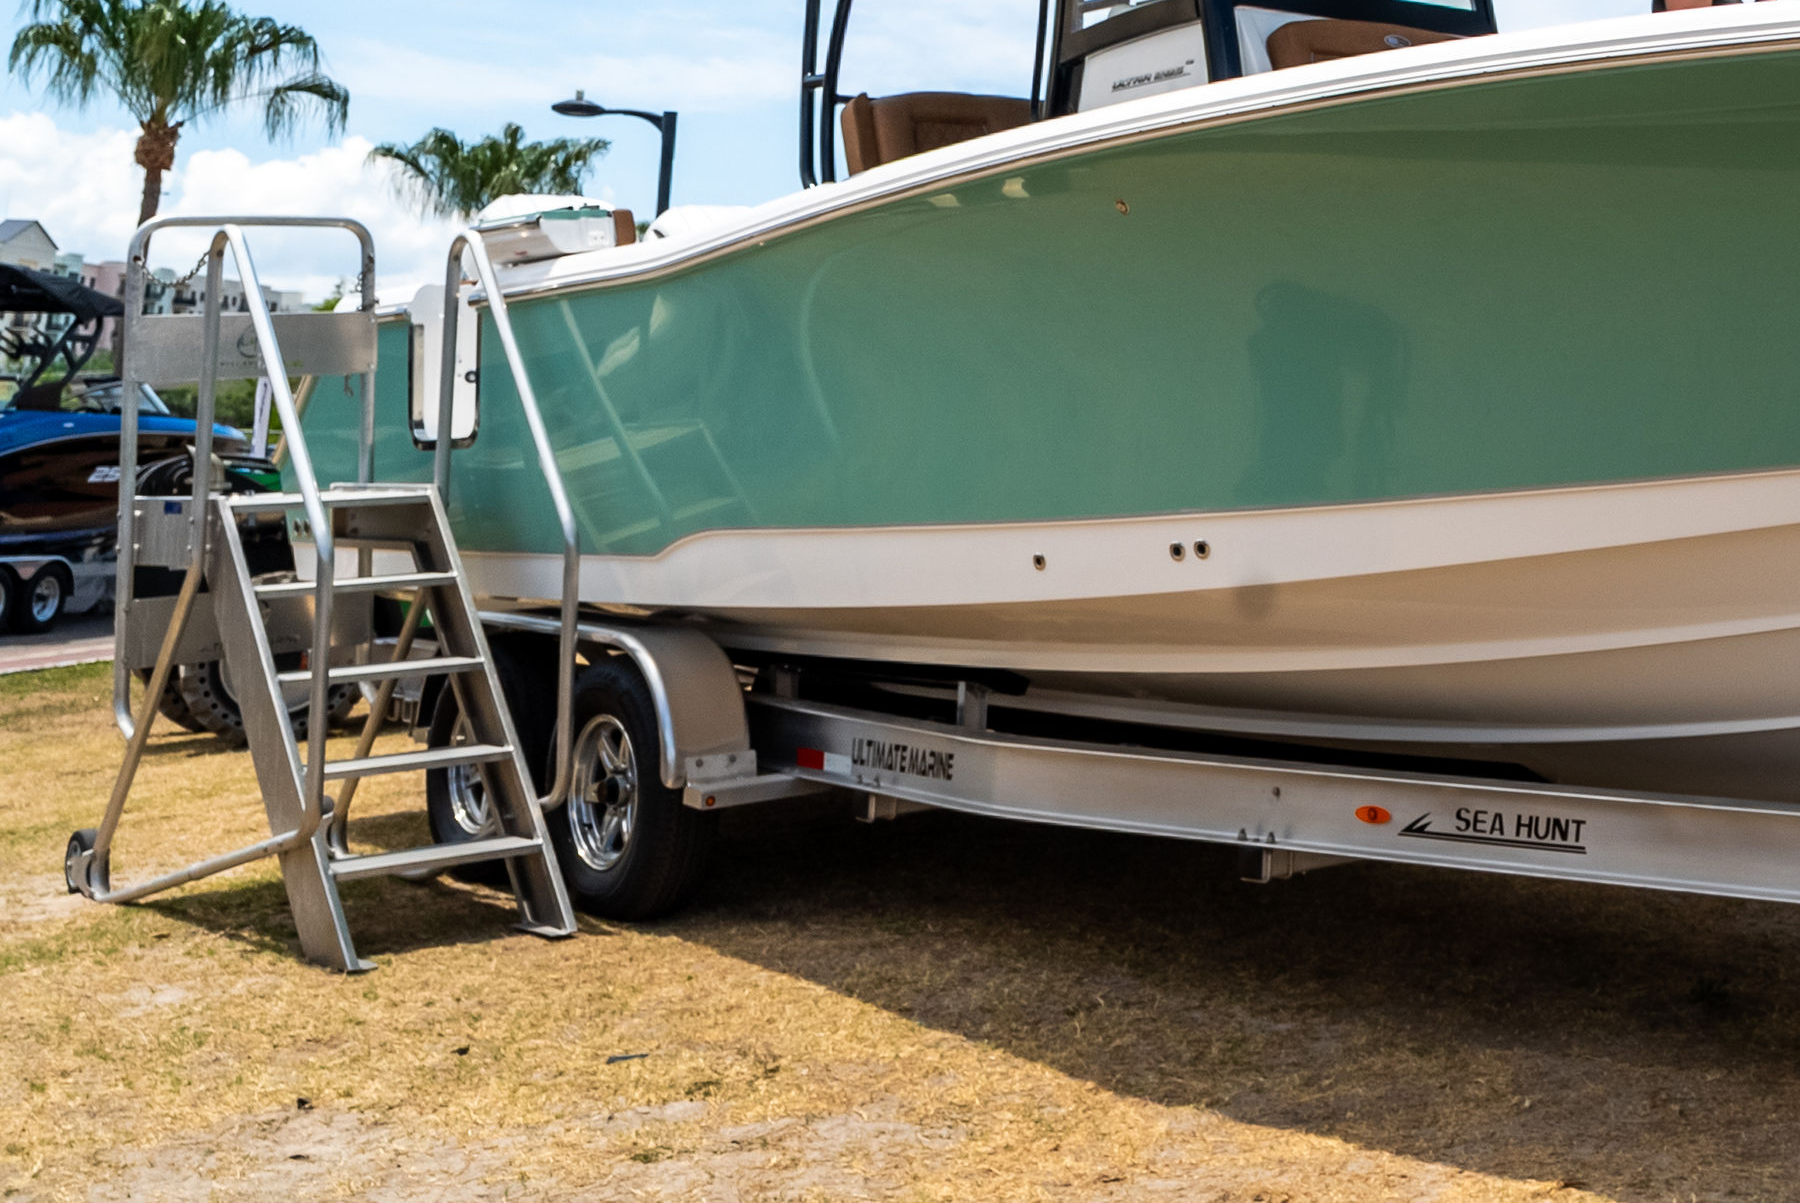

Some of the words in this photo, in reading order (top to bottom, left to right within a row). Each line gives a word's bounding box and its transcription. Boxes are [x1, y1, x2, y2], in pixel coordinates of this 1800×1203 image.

[852, 738, 908, 773] ULTIMATE
[908, 746, 955, 781] MARINE
[1455, 807, 1505, 836] SEA
[1515, 814, 1587, 843] HUNT
